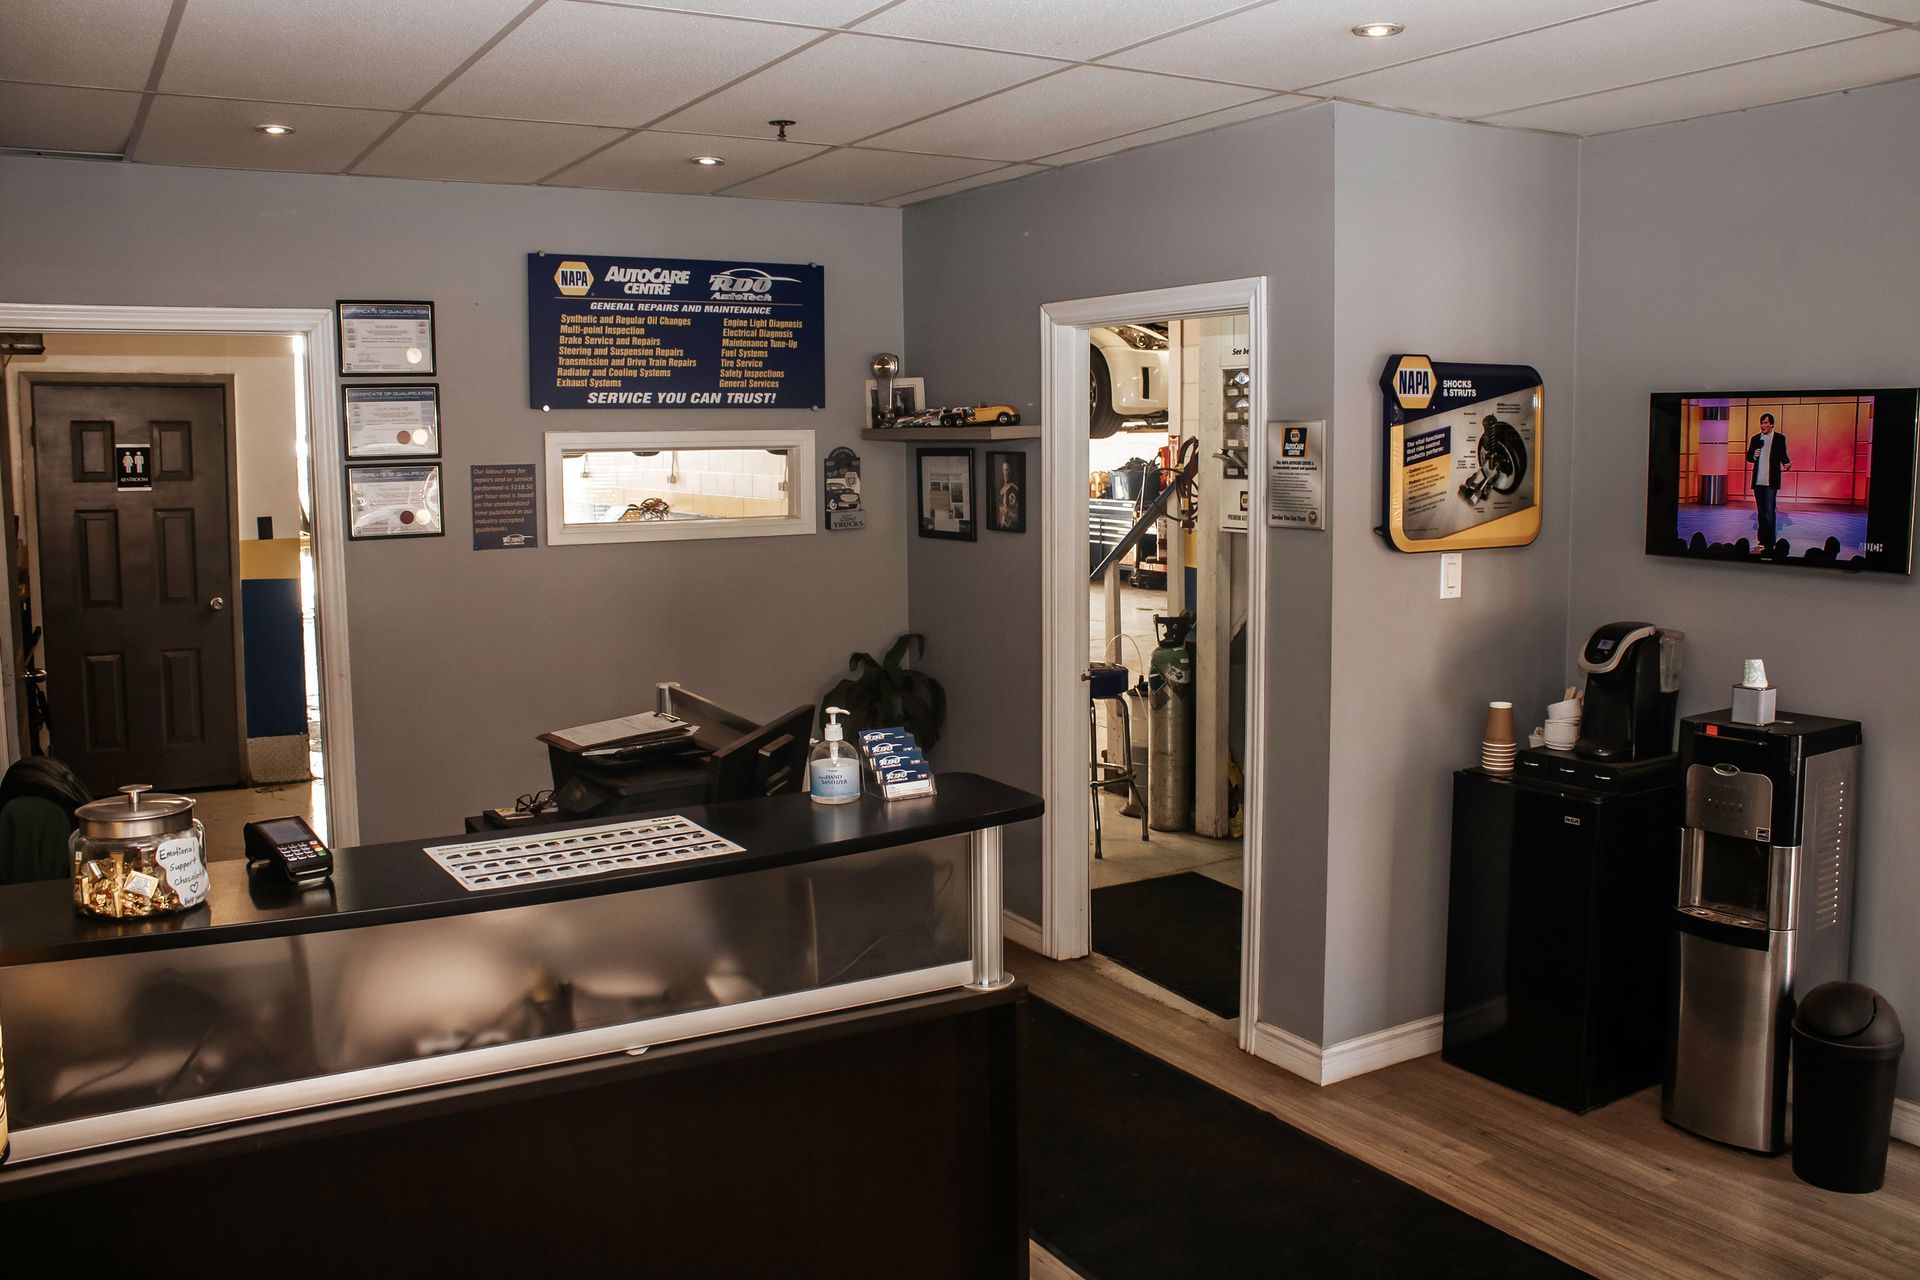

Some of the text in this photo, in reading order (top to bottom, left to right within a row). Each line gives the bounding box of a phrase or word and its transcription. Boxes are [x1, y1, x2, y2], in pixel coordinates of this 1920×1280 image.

[561, 270, 588, 287] NAPA
[709, 275, 772, 292] RDO
[623, 282, 672, 295] CENTRE
[710, 292, 772, 301] AutoTech
[590, 302, 772, 315] GENERAL REPAIRS AND MAINTENANCE
[561, 314, 692, 326] Synthetic and Regular Oil Changes
[723, 318, 803, 329] Engine Light Diagnosis
[560, 324, 645, 335] Multi-point Inspection
[722, 328, 793, 339] Electrical Diagnosis
[559, 335, 661, 346] Brake Service and Repairs
[722, 338, 798, 349] Maintenance Tune-Up
[558, 346, 684, 357] Steering and Suspension Repairs
[721, 349, 769, 358] Fuel Systems
[558, 357, 697, 368] Transmission and Drive Train Repairs
[720, 359, 763, 368] Tire Service
[557, 367, 671, 378] Radiator and Cooling Systems
[720, 369, 785, 379] Safety Inspections
[556, 378, 622, 388] Exhaust Systems
[719, 379, 780, 389] General Services
[1399, 371, 1430, 394] NAPA
[1443, 380, 1472, 388] SHOCKS
[587, 392, 777, 404] SERVICE YOU CAN TRUST!
[1443, 388, 1477, 397] & STRUTS
[833, 520, 864, 529] TRUCKS
[1566, 817, 1580, 825] RCA
[159, 840, 196, 860] Emotional
